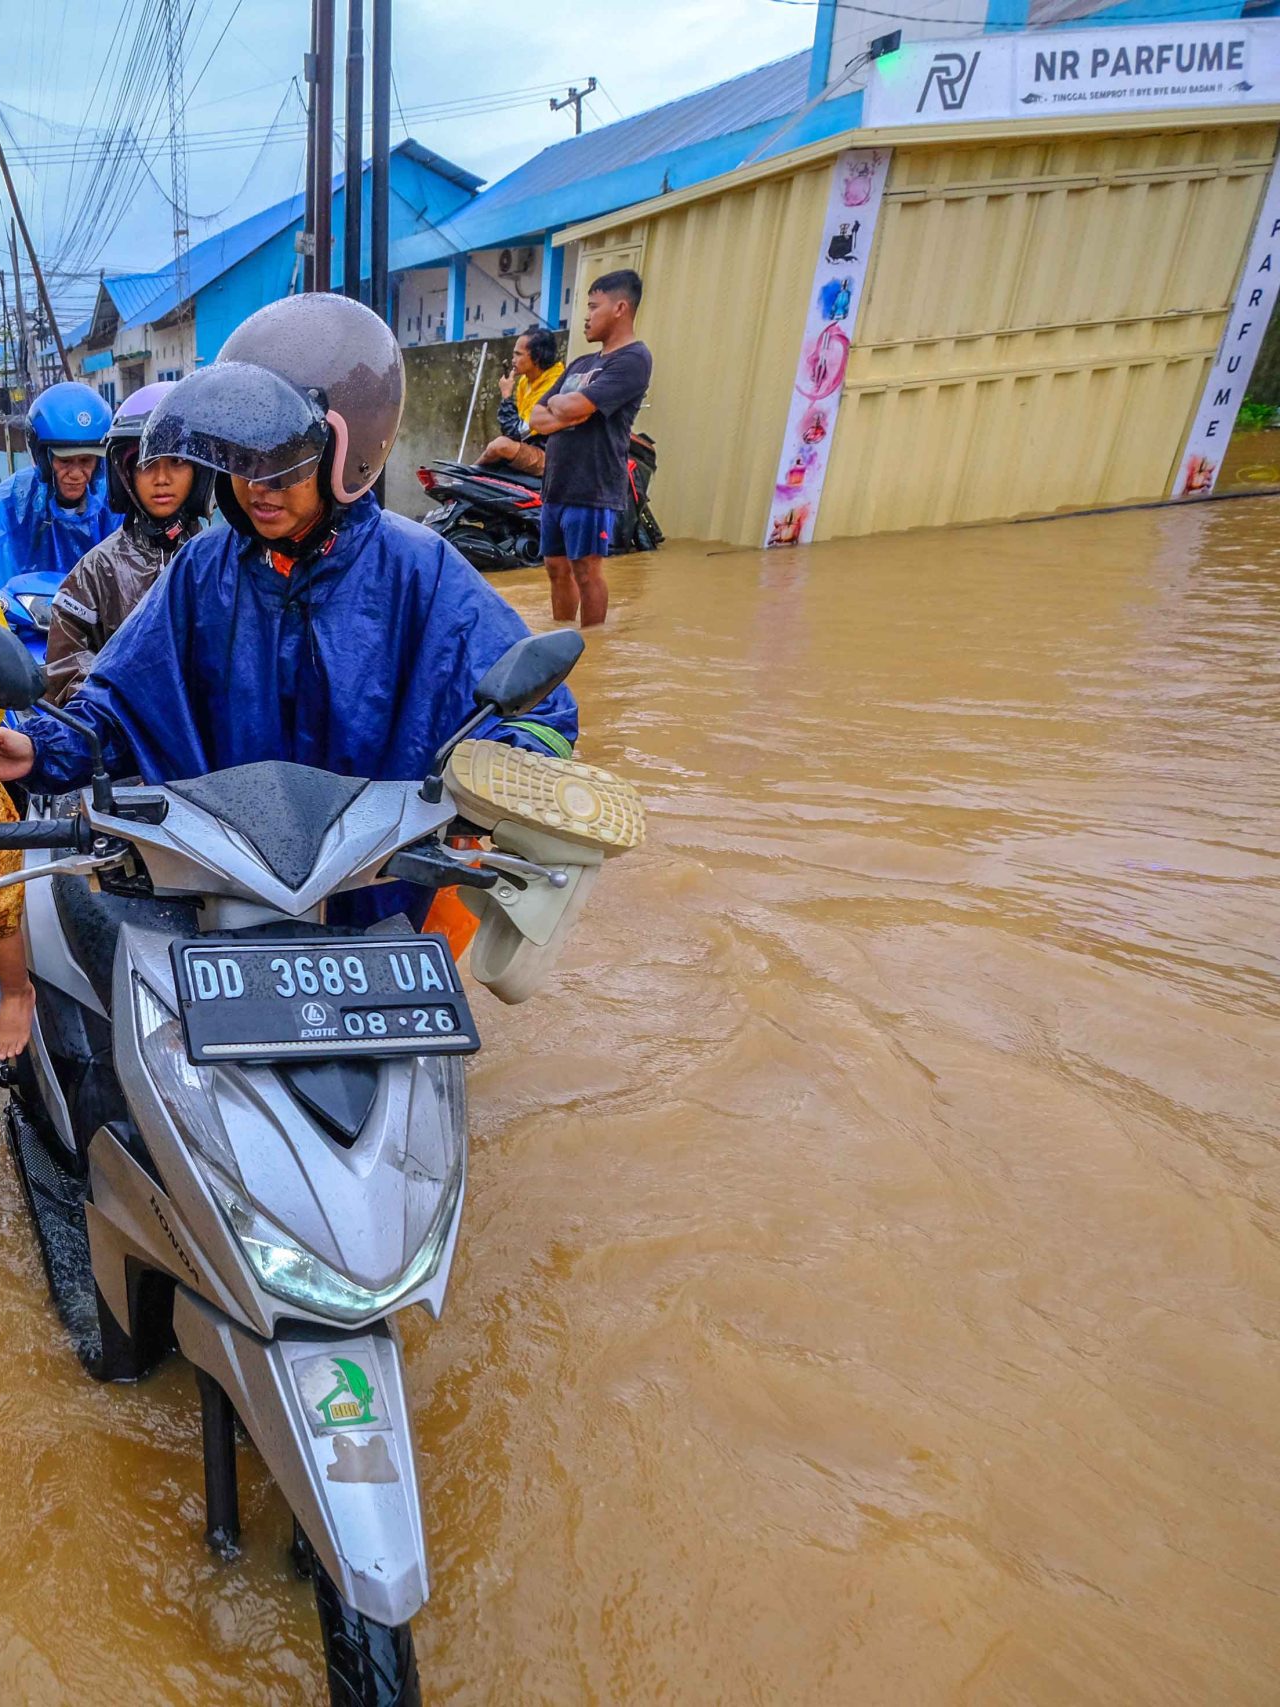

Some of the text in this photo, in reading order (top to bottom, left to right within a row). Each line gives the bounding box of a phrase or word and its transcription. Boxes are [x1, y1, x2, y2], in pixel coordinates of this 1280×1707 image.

[1033, 40, 1245, 82] NR PARFUME
[1089, 89, 1127, 100] SEMPROT
[1136, 87, 1151, 96] BYE
[1153, 86, 1168, 96] BYE
[1170, 86, 1187, 95] BAU
[192, 953, 445, 1000] DD 3689 UA
[301, 1027, 338, 1038] EXOTIC
[150, 1194, 200, 1284] HONDA
